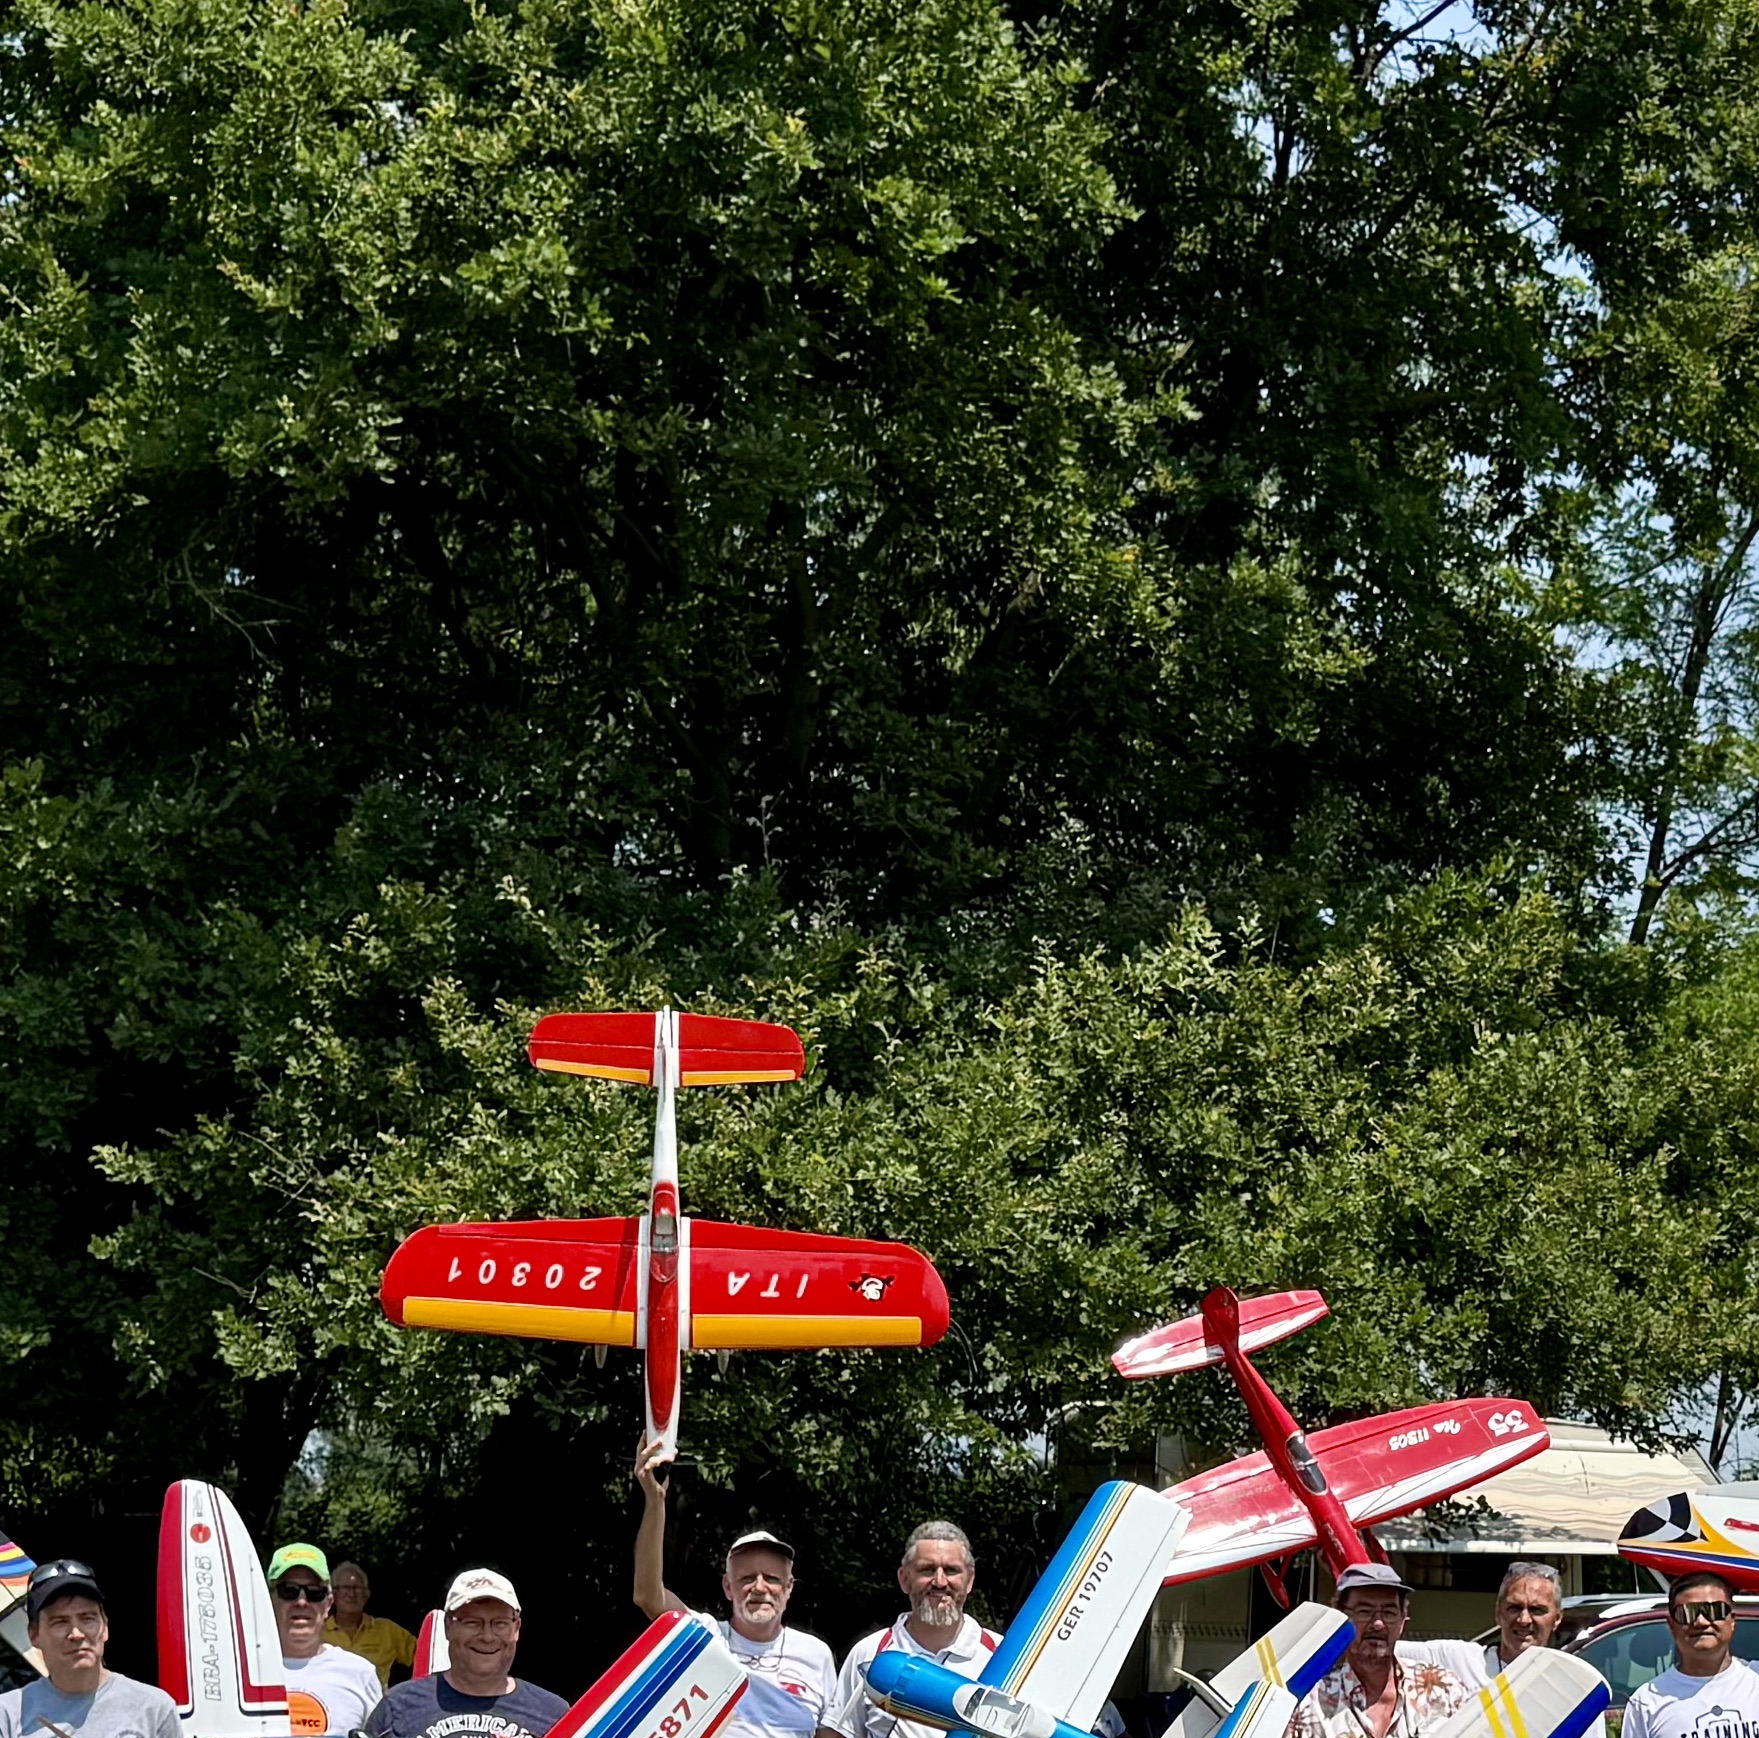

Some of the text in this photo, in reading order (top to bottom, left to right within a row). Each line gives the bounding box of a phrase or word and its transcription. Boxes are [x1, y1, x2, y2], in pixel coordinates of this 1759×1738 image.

[448, 1255, 810, 1299] ITA 20301
[1056, 1550, 1114, 1642] GER 19707
